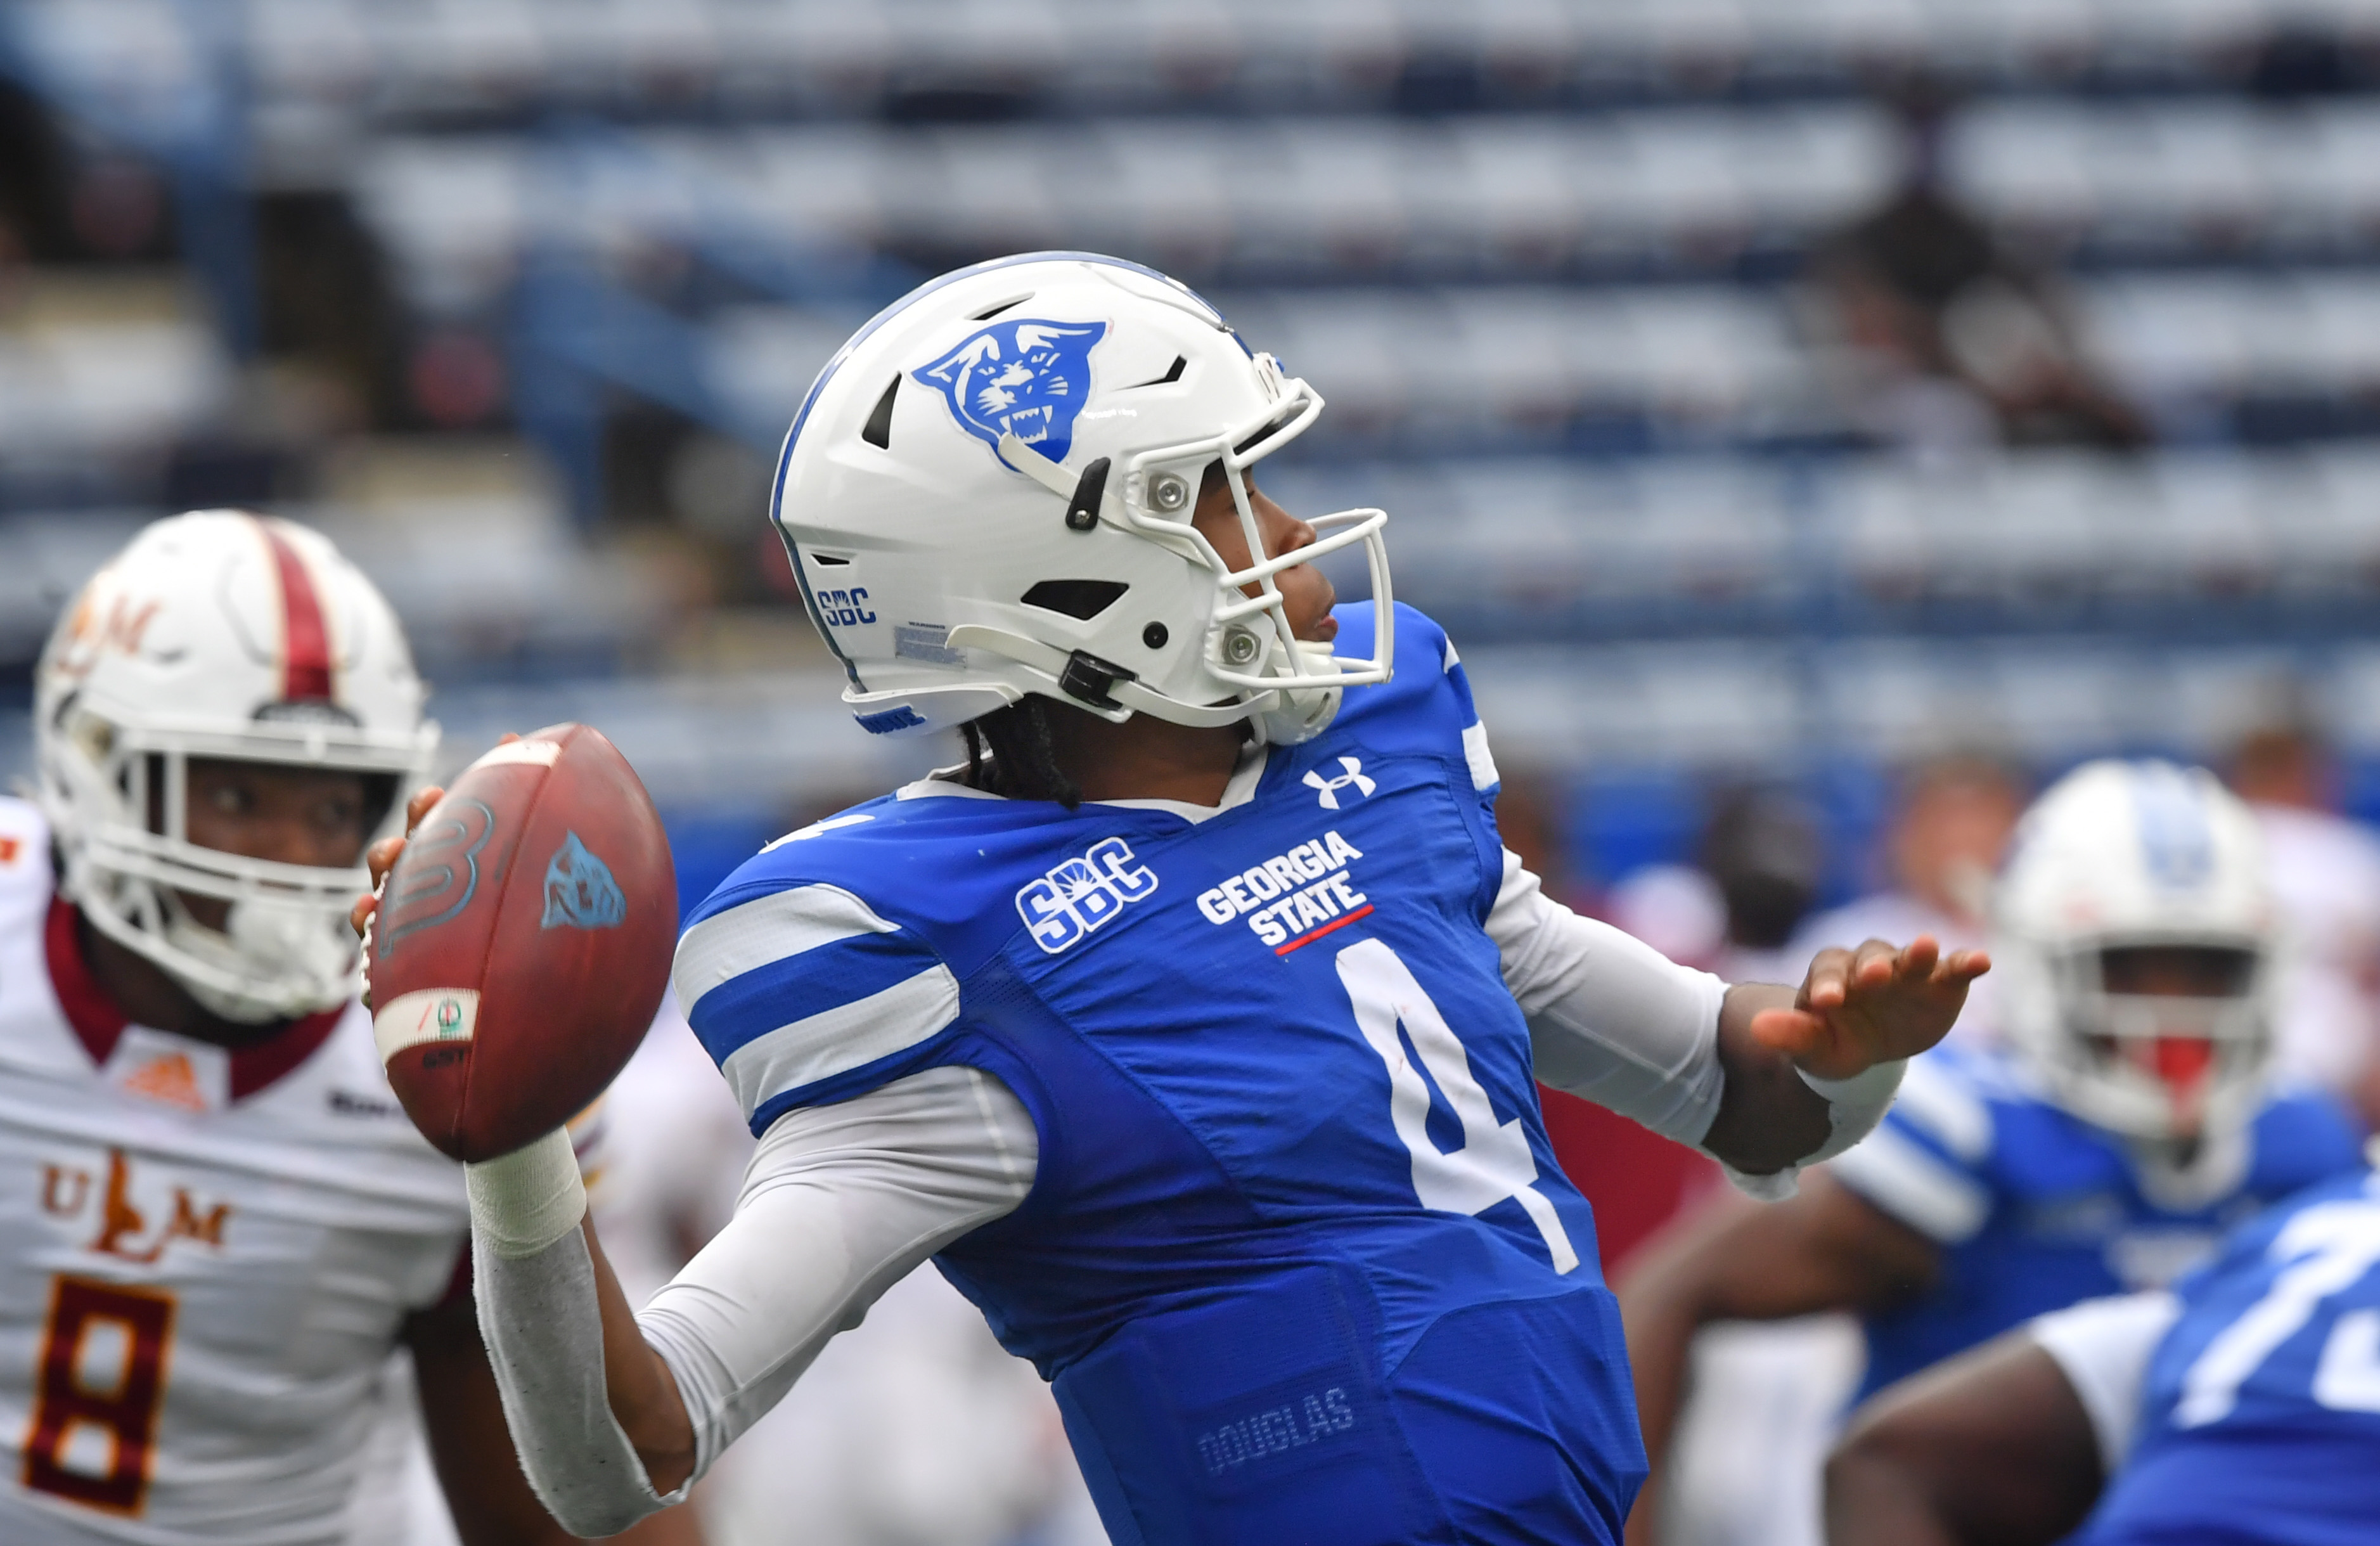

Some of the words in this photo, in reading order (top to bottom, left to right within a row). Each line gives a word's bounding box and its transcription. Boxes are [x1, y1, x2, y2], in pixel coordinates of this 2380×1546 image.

[817, 587, 877, 626] SBC
[1015, 836, 1159, 954] SBC
[1196, 830, 1363, 925] GEORGIA
[1248, 869, 1367, 946] STATE
[1335, 937, 1581, 1276] 4
[21, 1270, 180, 1520] 8
[1198, 1387, 1353, 1474] DOUGLAS
